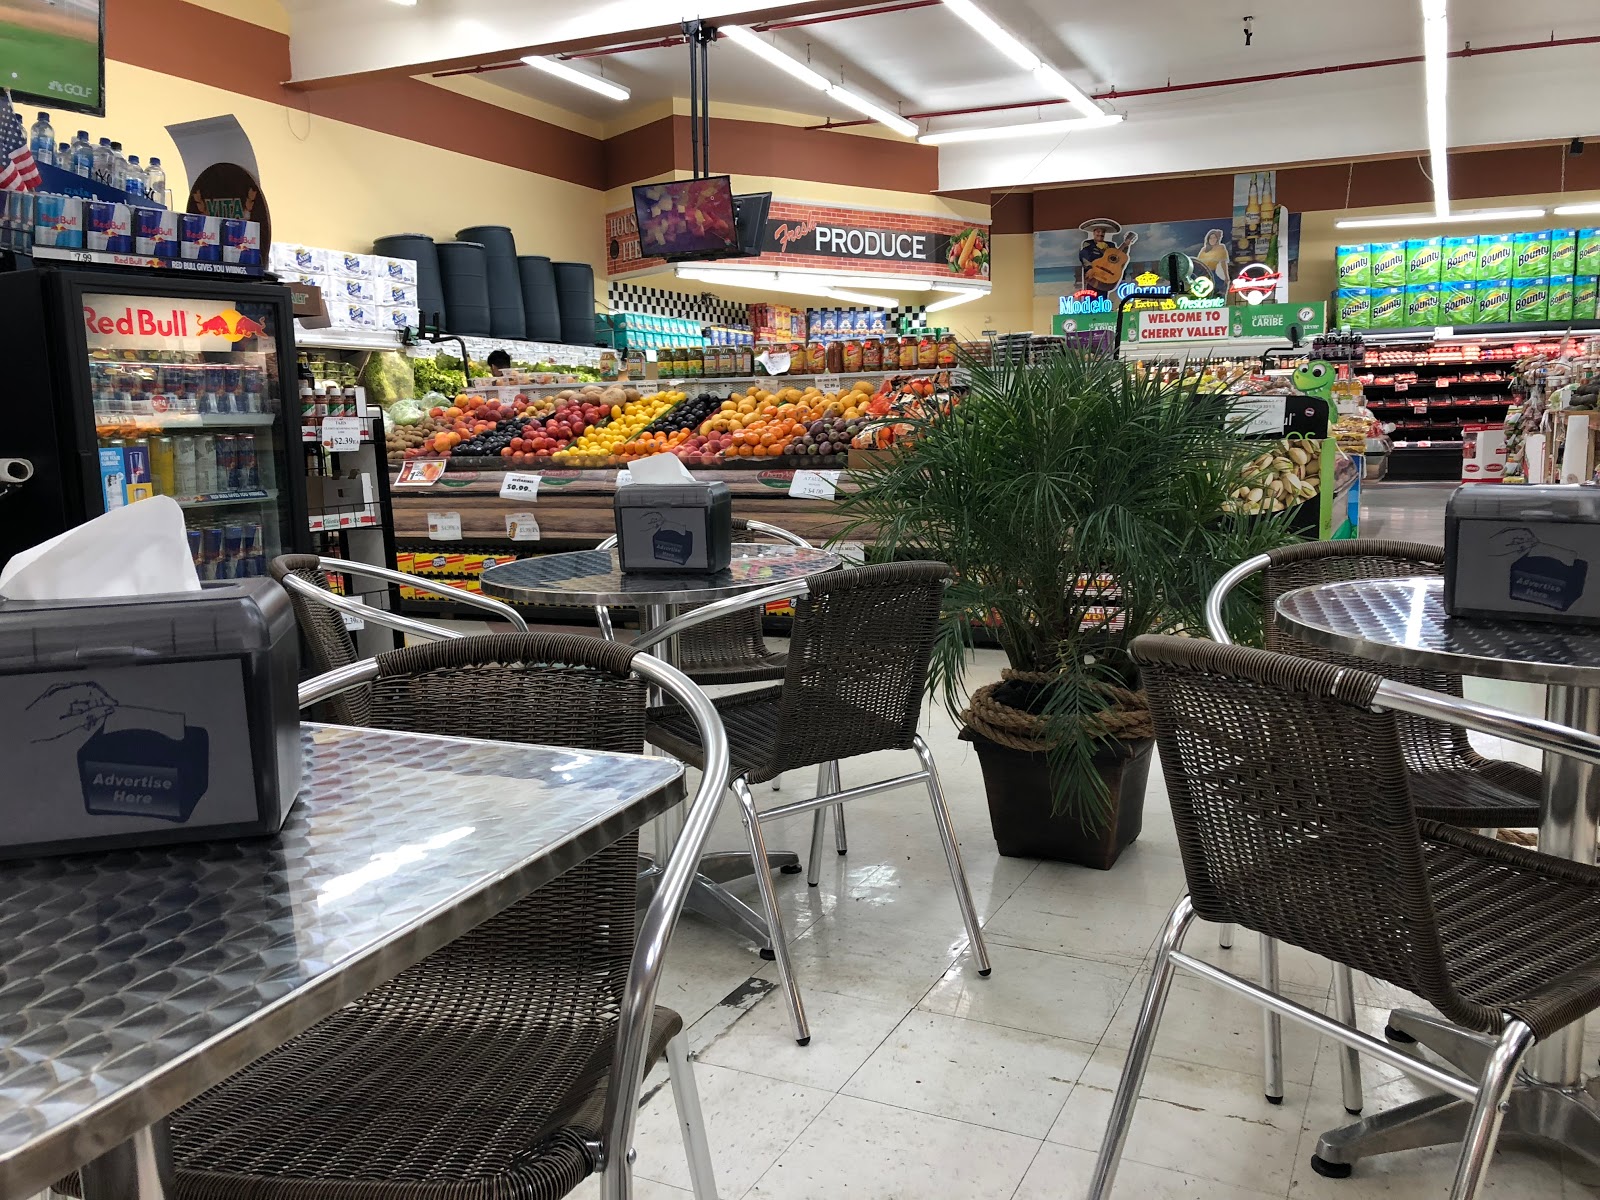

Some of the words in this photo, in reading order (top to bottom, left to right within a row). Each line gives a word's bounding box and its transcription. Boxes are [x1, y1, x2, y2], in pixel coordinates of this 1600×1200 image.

[64, 83, 93, 98] GOLF
[204, 197, 245, 219] VITA
[111, 221, 126, 230] Bull
[609, 213, 639, 238] HOUS
[774, 210, 818, 253] Fresh
[814, 226, 927, 260] PRODUCE
[113, 256, 128, 265] Red
[128, 257, 143, 266] Bull
[622, 240, 643, 262] ITE
[1410, 249, 1440, 272] Bounty
[1446, 249, 1477, 270] Bounty
[1480, 246, 1511, 268] Bounty
[1518, 245, 1549, 267] Bounty
[1552, 245, 1575, 261] Bounty
[171, 261, 183, 270] RED
[183, 262, 197, 271] BULL
[196, 263, 213, 272] GIVES
[212, 265, 225, 273] YOU
[1340, 256, 1368, 278] Bounty
[1374, 254, 1403, 276] Bounty
[1073, 289, 1098, 298] CERVEZA
[1176, 296, 1225, 309] Presidente
[1479, 291, 1510, 312] Bounty
[1515, 290, 1546, 312] Bounty
[1059, 295, 1113, 315] Modelo
[1134, 299, 1159, 309] Extra
[1341, 298, 1370, 320] Bounty
[1373, 297, 1402, 318] Bounty
[1408, 295, 1439, 315] Bounty
[1444, 294, 1476, 314] Bounty
[83, 307, 132, 336] Red
[137, 309, 188, 337] Bull
[1148, 312, 1202, 324] WELCOME
[1205, 311, 1221, 322] TO
[1251, 317, 1284, 327] CARIBE
[1141, 328, 1185, 339] CHERRY
[1187, 326, 1228, 338] VALLEY
[656, 543, 682, 554] Advertise
[1515, 576, 1562, 593] Advertise
[1525, 588, 1549, 599] Here
[91, 772, 173, 790] Advertise
[112, 789, 154, 804] Here
